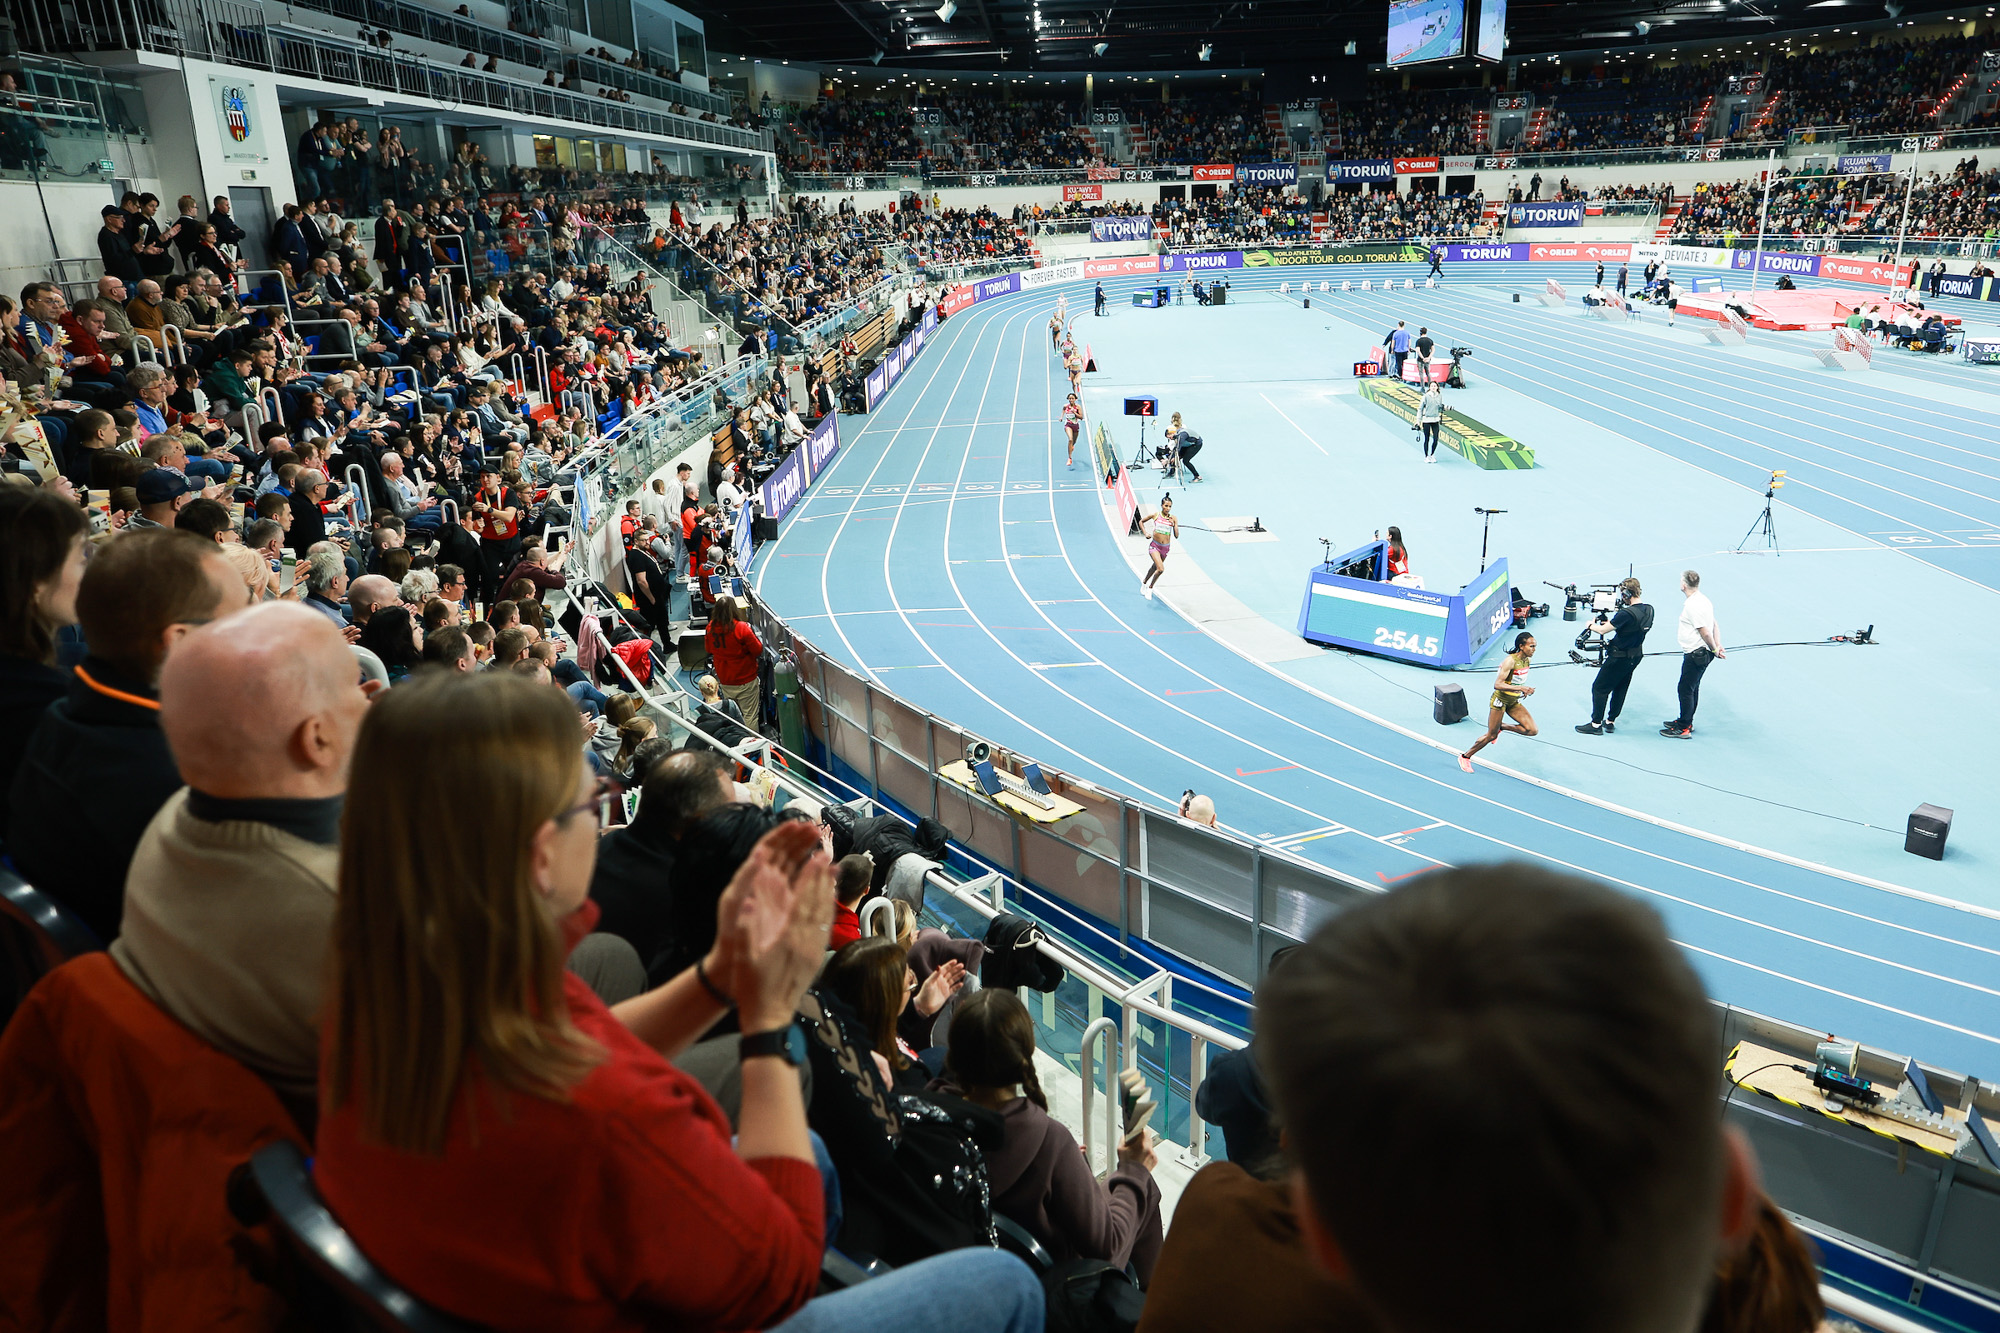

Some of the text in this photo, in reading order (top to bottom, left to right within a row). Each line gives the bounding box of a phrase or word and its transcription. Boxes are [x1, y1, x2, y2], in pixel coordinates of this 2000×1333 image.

[1728, 82, 1741, 92] F3
[1497, 97, 1527, 107] E3 F3
[762, 108, 770, 118] A3
[929, 114, 939, 122] C3
[1093, 113, 1118, 122] C3 D3
[1902, 136, 1938, 149] G2 H2
[1686, 150, 1700, 159] F2
[1484, 157, 1516, 167] E2 F2
[1844, 157, 1878, 165] KUJAWY
[1125, 171, 1136, 180] C2
[1141, 170, 1153, 180] D2
[1249, 165, 1294, 180] TORUŃ
[1343, 162, 1390, 177] TORUŃ
[846, 177, 864, 188] A2 B2
[972, 174, 996, 184] B2 C2
[1526, 205, 1579, 222] TORUŃ
[1106, 219, 1148, 236] TORUŃ
[1274, 252, 1424, 264] INDOOR TOUR GOLD TORUŃ 2025
[1461, 246, 1511, 260] TORUŃ
[1664, 250, 1700, 262] DEVIATE
[1702, 252, 1708, 262] 3
[1184, 253, 1226, 268] TORUŃ
[1763, 257, 1812, 272] TORUŃ
[1031, 267, 1079, 284] FOREVER. FASTER.
[1838, 265, 1864, 275] ORLEN
[984, 277, 1010, 296] TORUŃ
[1939, 279, 1973, 295] TORUŃ
[1355, 364, 1378, 375] 1:00
[1142, 400, 1151, 416] 2
[1374, 627, 1439, 656] 2:54.5
